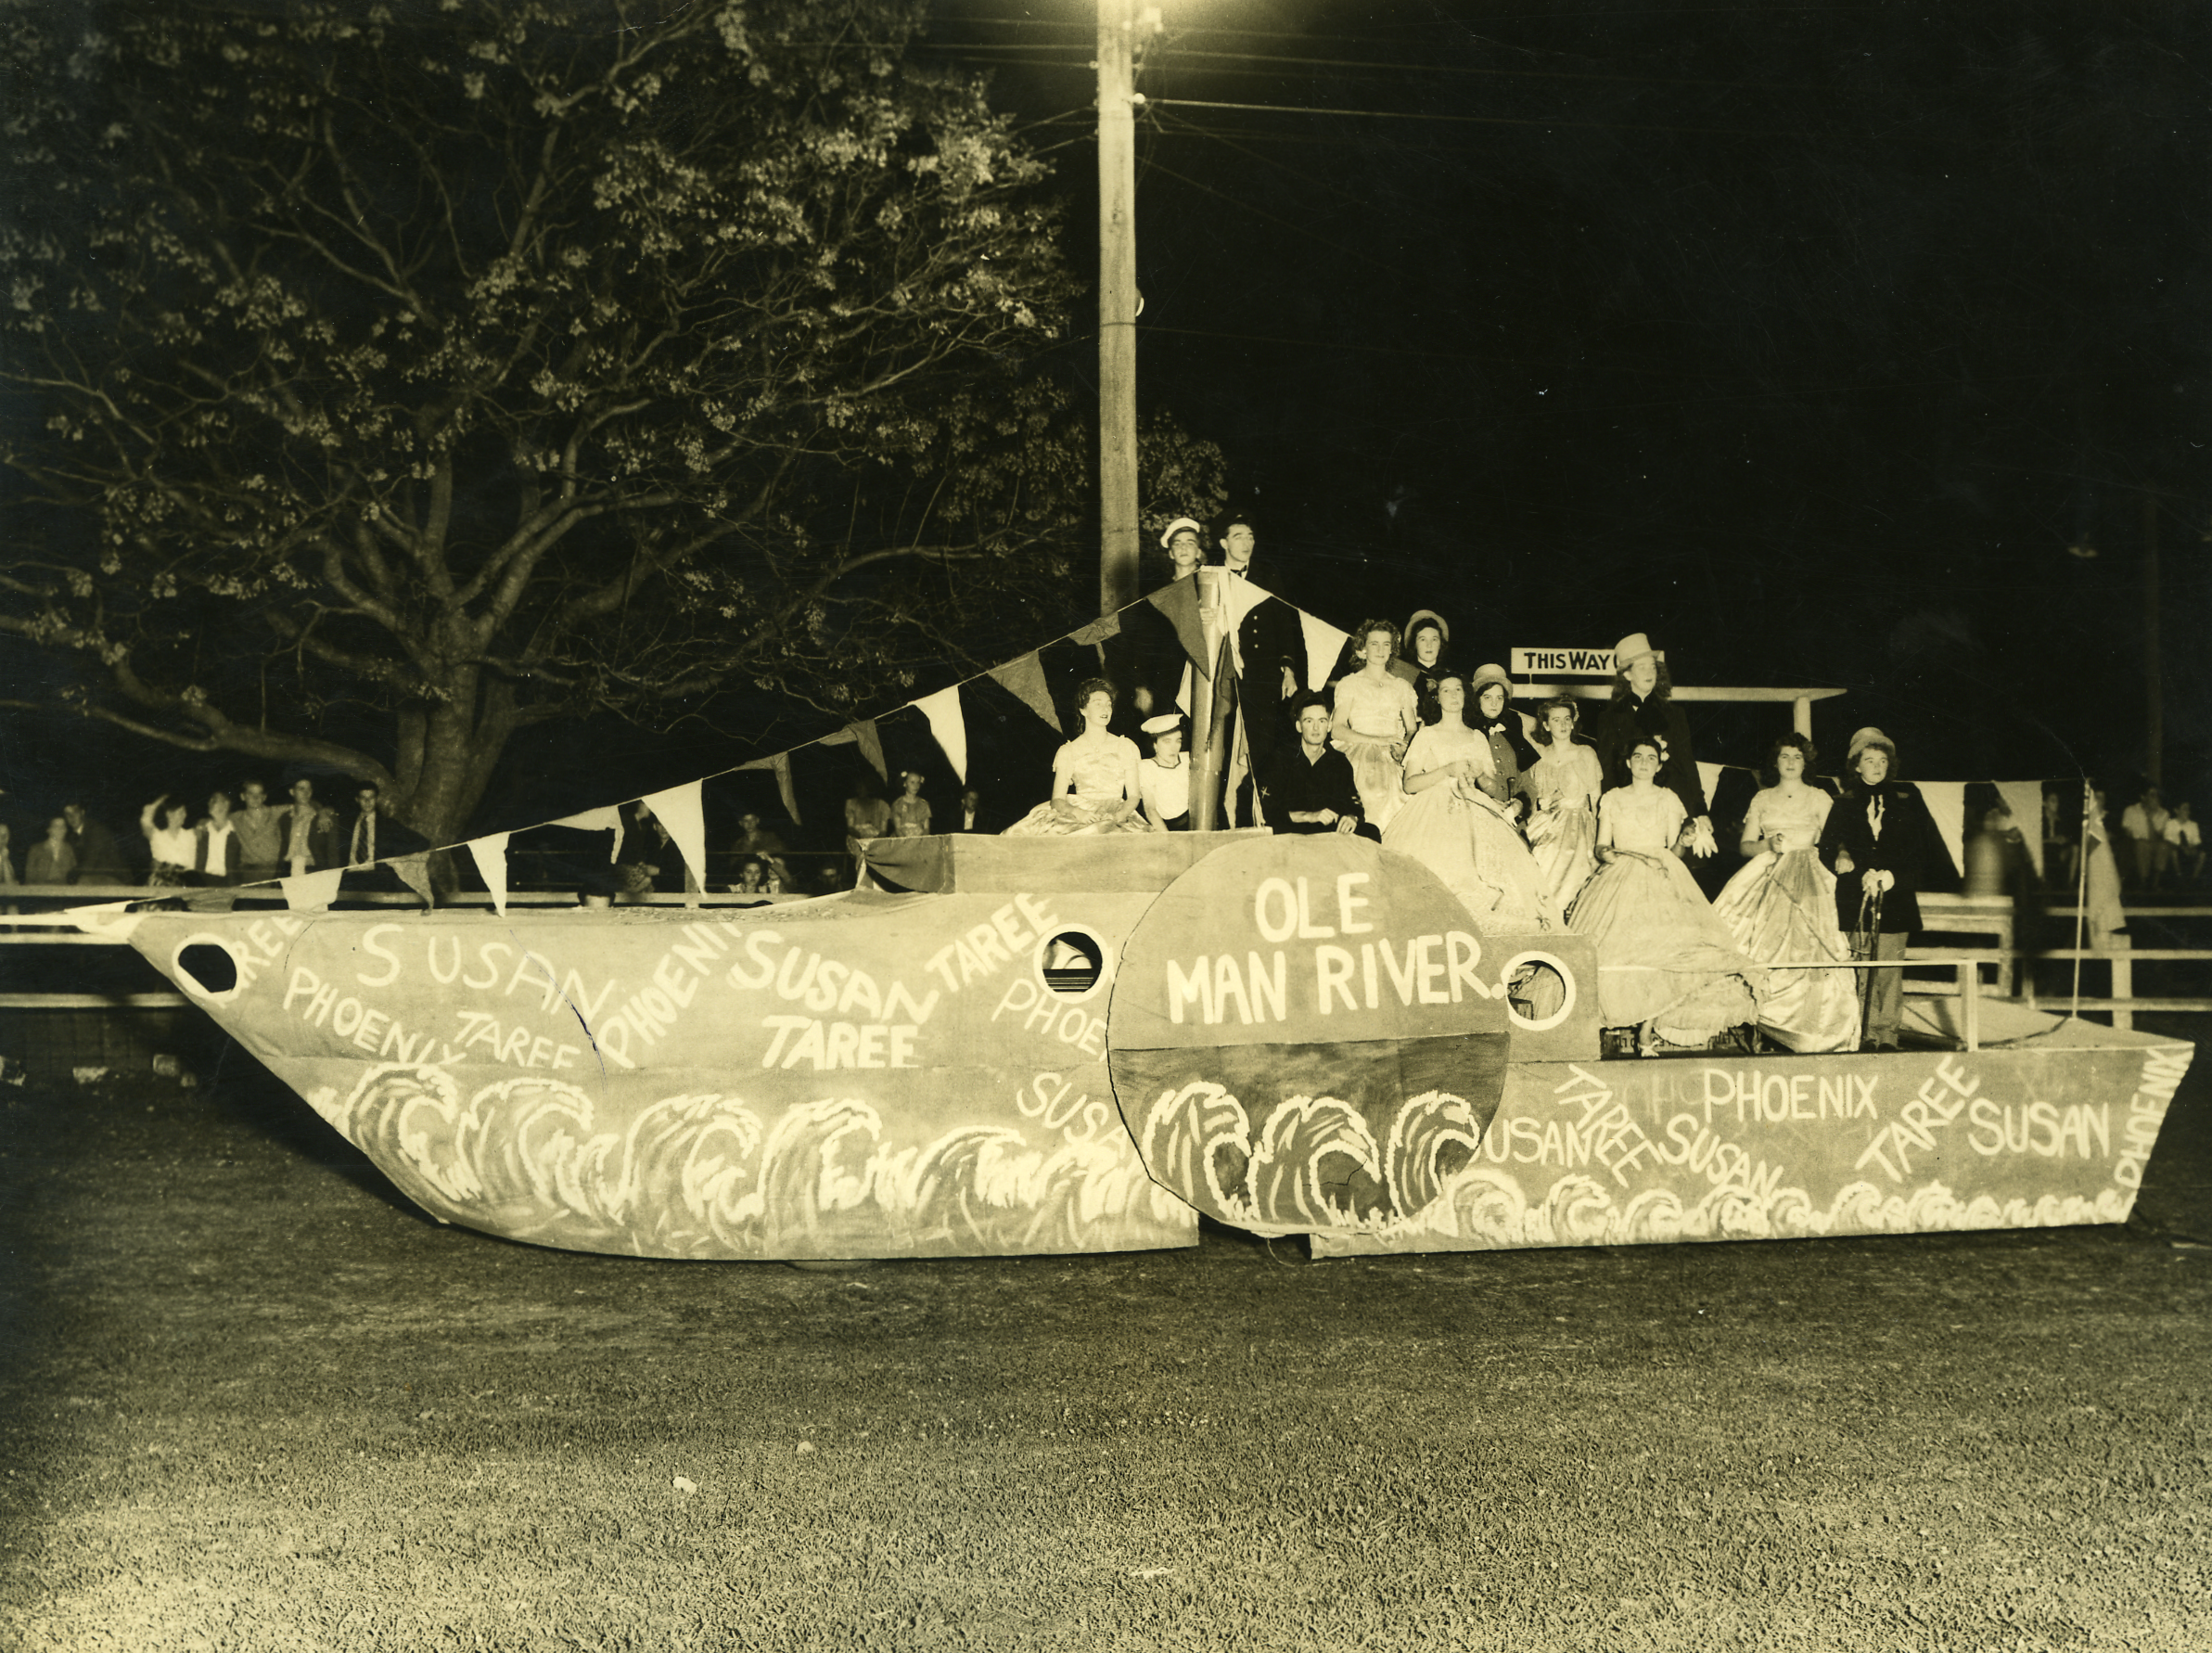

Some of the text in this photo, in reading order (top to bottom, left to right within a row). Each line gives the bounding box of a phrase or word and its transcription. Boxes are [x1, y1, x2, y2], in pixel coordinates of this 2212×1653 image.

[1524, 652, 1566, 670] THIS
[1568, 651, 1611, 671] WAY
[924, 893, 1059, 993] TAREE
[1255, 872, 1374, 942] OLE
[356, 924, 616, 1023] SUSAN
[726, 930, 940, 1024] SUSAN
[1167, 930, 1505, 1025] MAN RIVER.
[761, 1015, 921, 1070] TAREE
[991, 978, 1109, 1062] PHOE
[1554, 1064, 1663, 1188] TAREE
[1703, 1069, 1879, 1123] PHOENIX
[1855, 1055, 1980, 1184] TAREE
[1968, 1098, 2110, 1160] SUSAN
[1468, 1117, 1593, 1168] USAN
[1658, 1113, 1784, 1196] SUSAN
